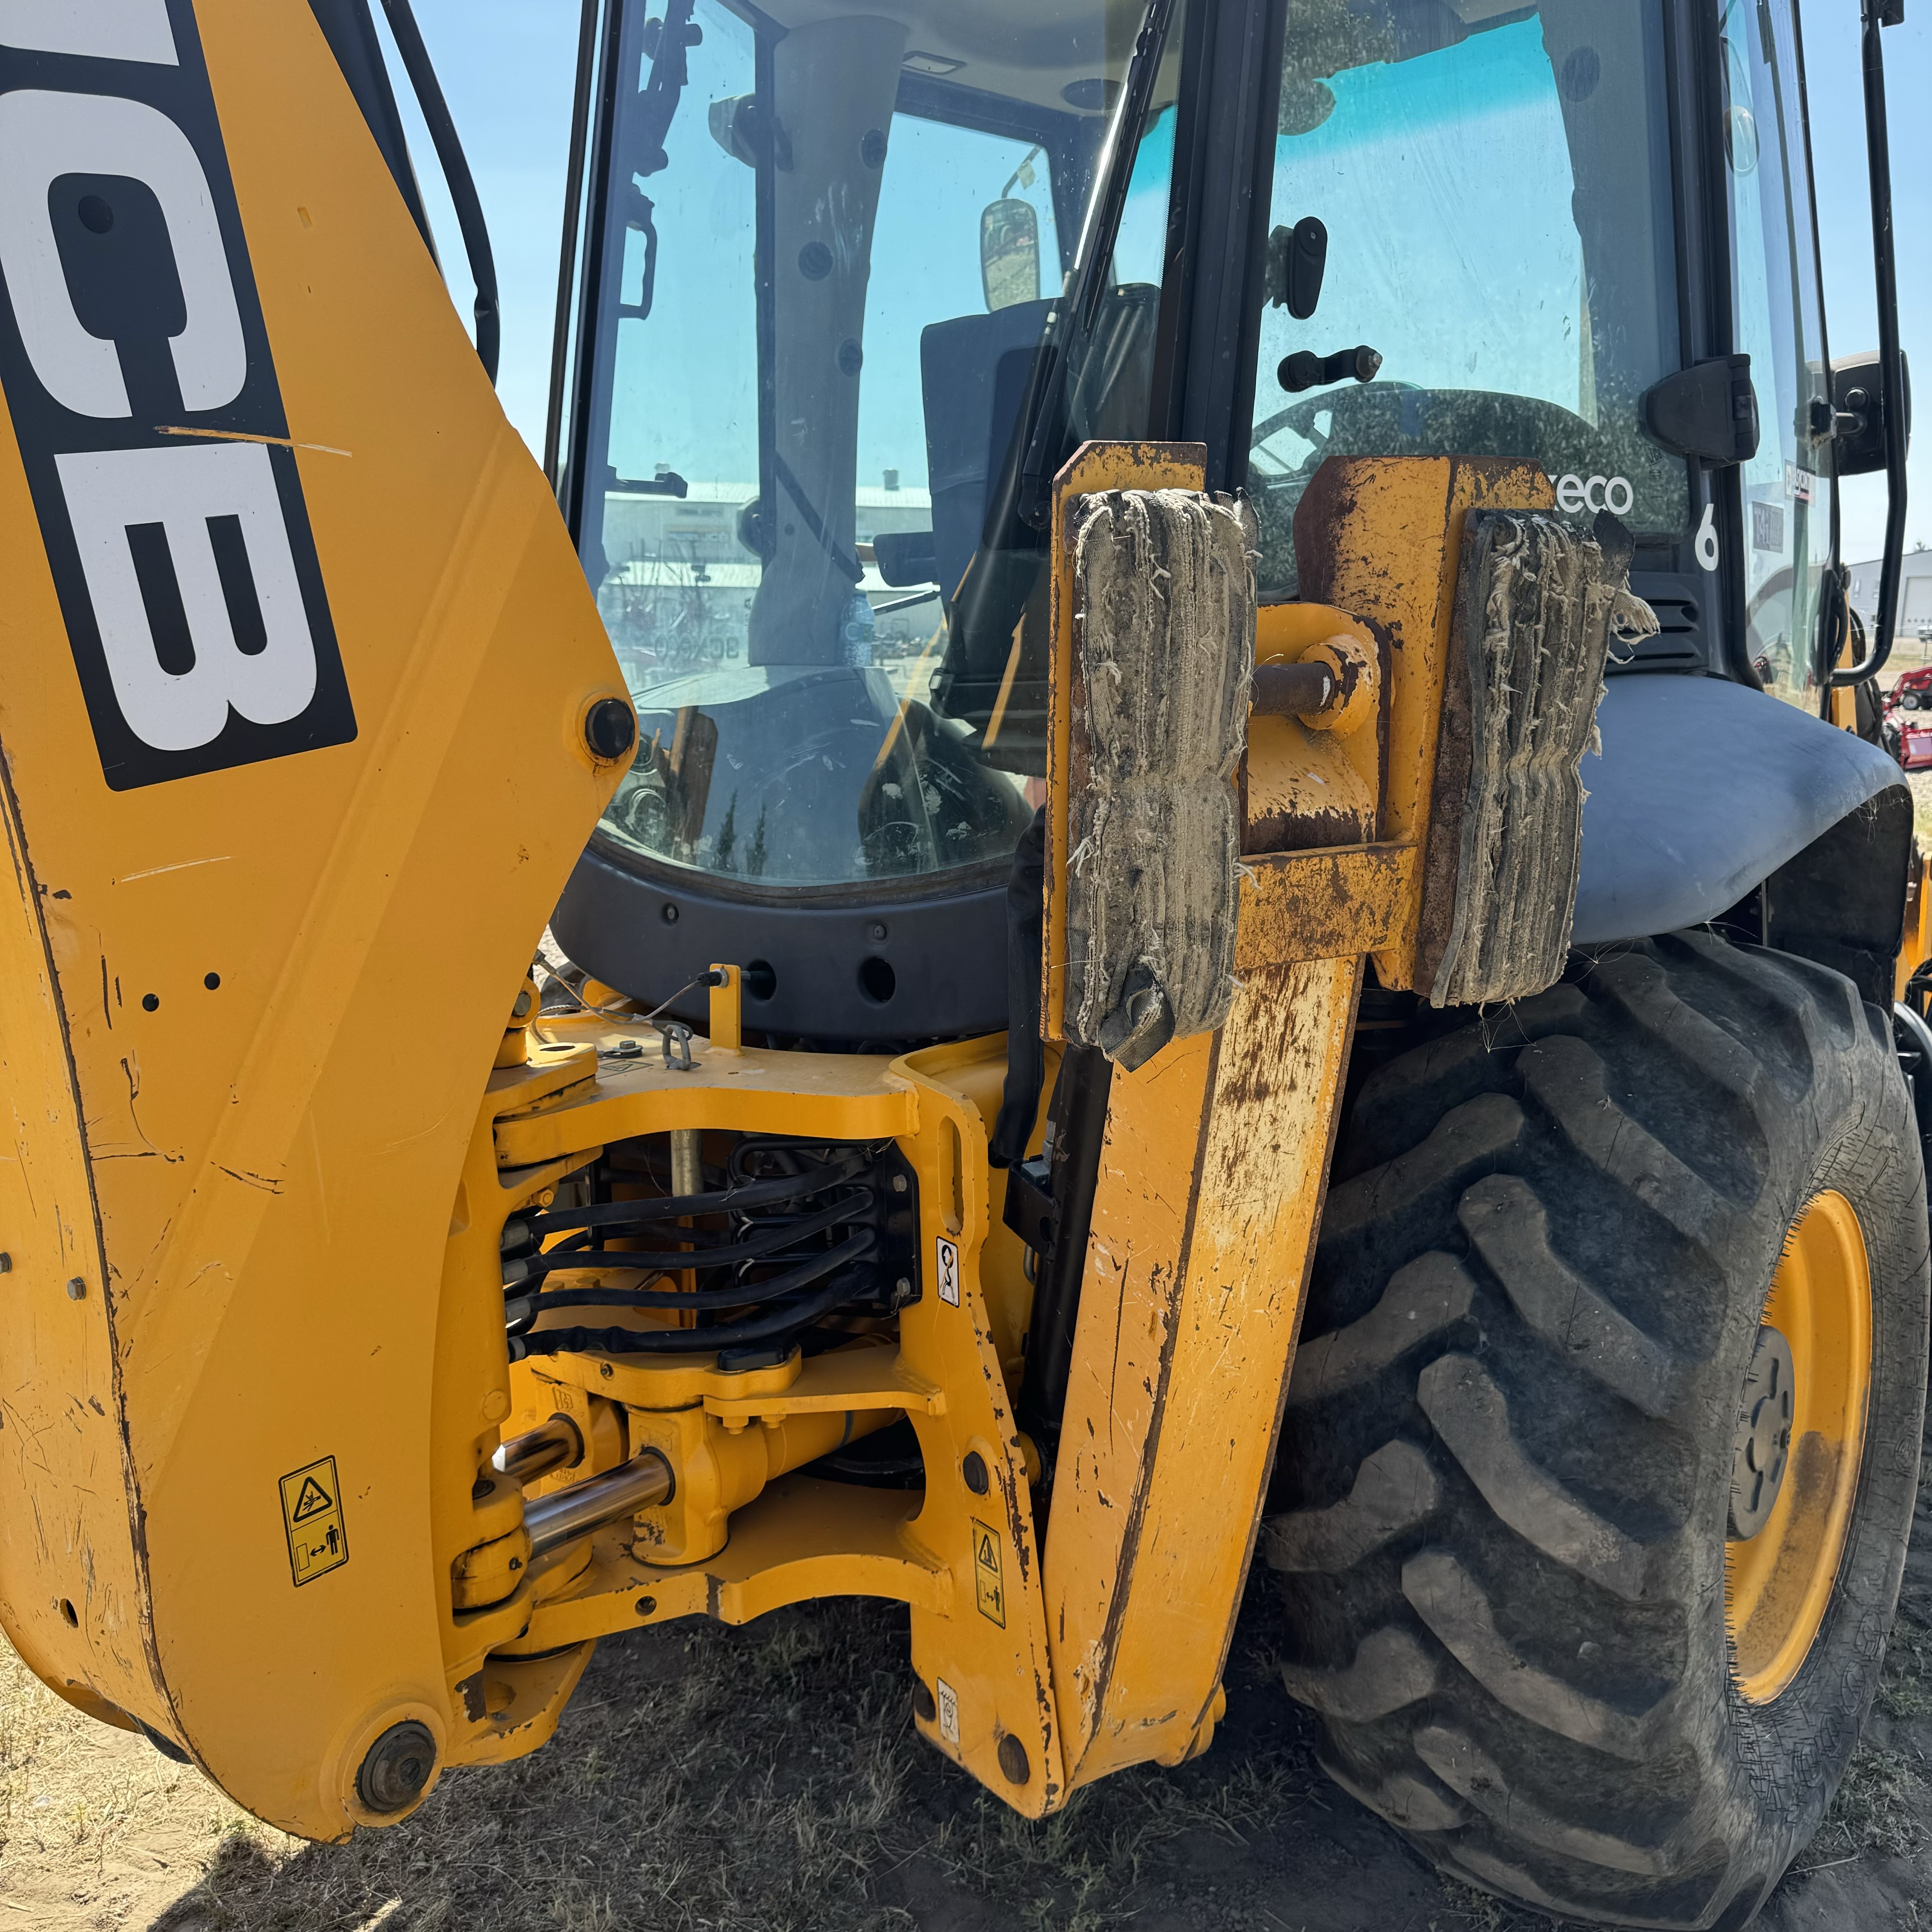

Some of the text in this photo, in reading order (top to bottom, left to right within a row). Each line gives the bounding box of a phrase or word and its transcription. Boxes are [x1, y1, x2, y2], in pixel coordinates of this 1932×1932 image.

[0, 0, 317, 752] CB
[1548, 474, 1633, 515] eco
[1695, 503, 1719, 571] 6
